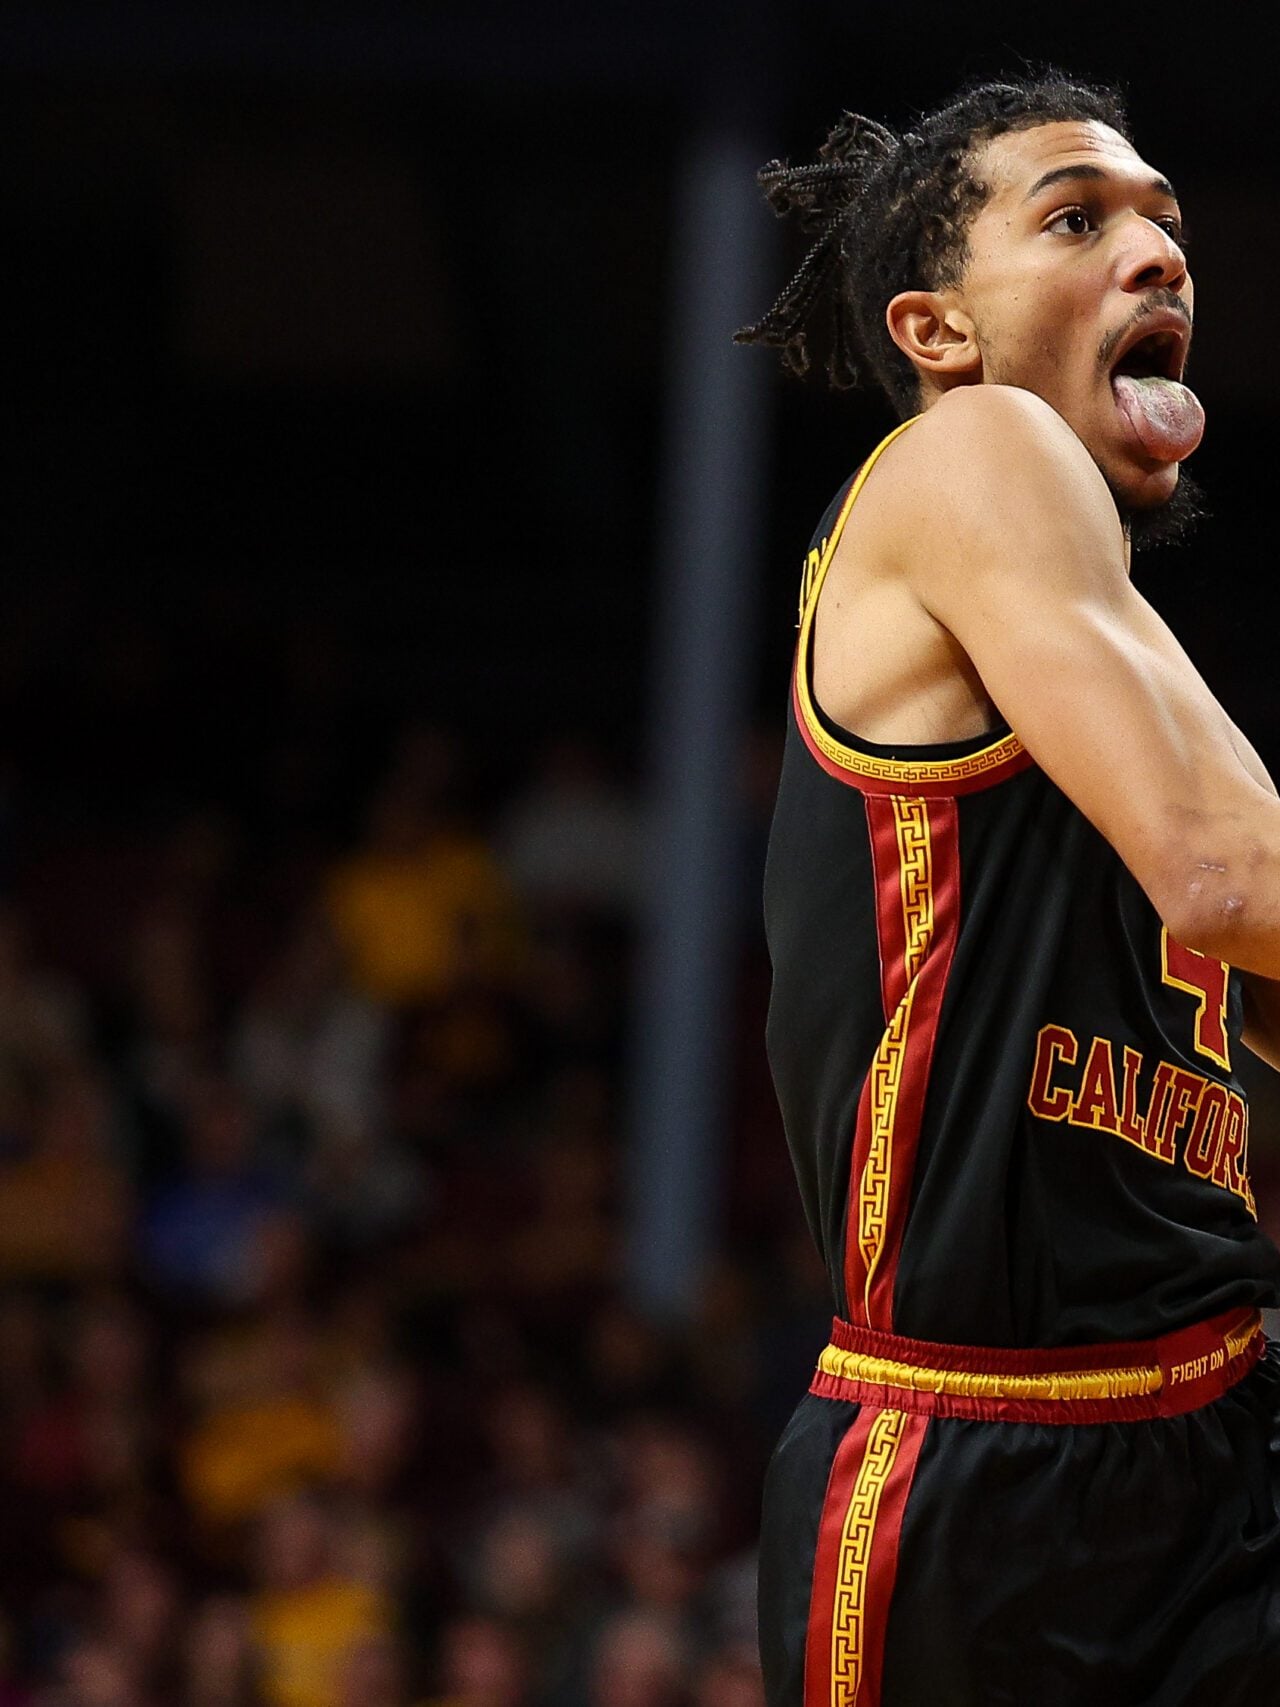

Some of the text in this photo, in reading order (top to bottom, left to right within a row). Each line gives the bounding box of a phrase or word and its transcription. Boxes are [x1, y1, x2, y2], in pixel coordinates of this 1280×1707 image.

[1027, 1023, 1257, 1222] CALIFOR
[1170, 1348, 1224, 1386] FIGHT ON
